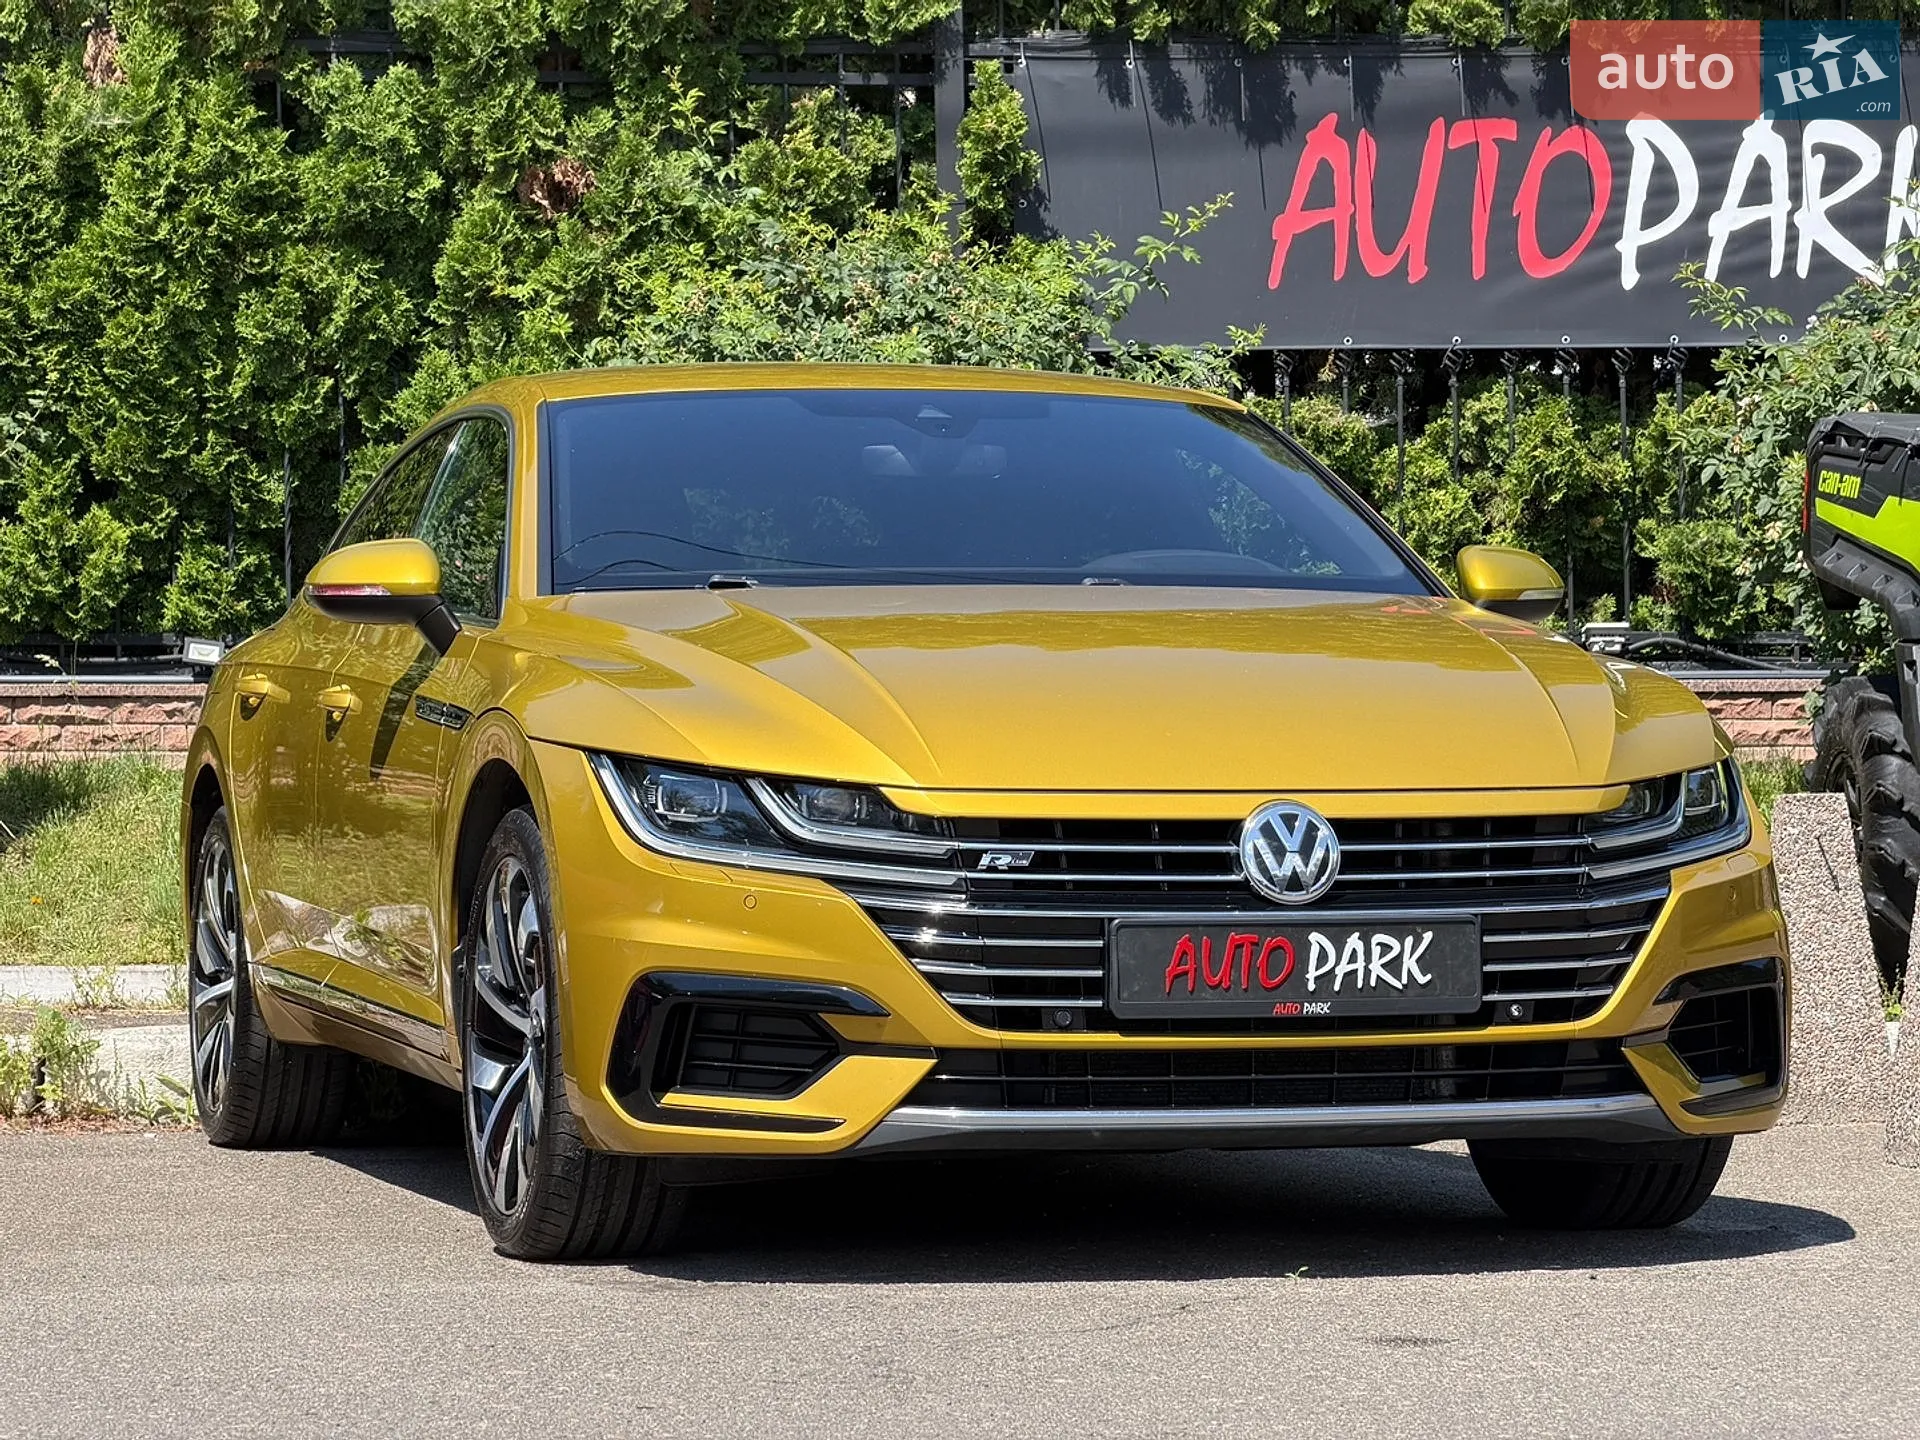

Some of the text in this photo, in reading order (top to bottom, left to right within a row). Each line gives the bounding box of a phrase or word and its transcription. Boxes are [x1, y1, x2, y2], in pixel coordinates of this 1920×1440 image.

[1818, 470, 1861, 499] can-am
[1165, 931, 1434, 995] AUTO PARK
[1273, 1001, 1331, 1016] AUTO PARK
